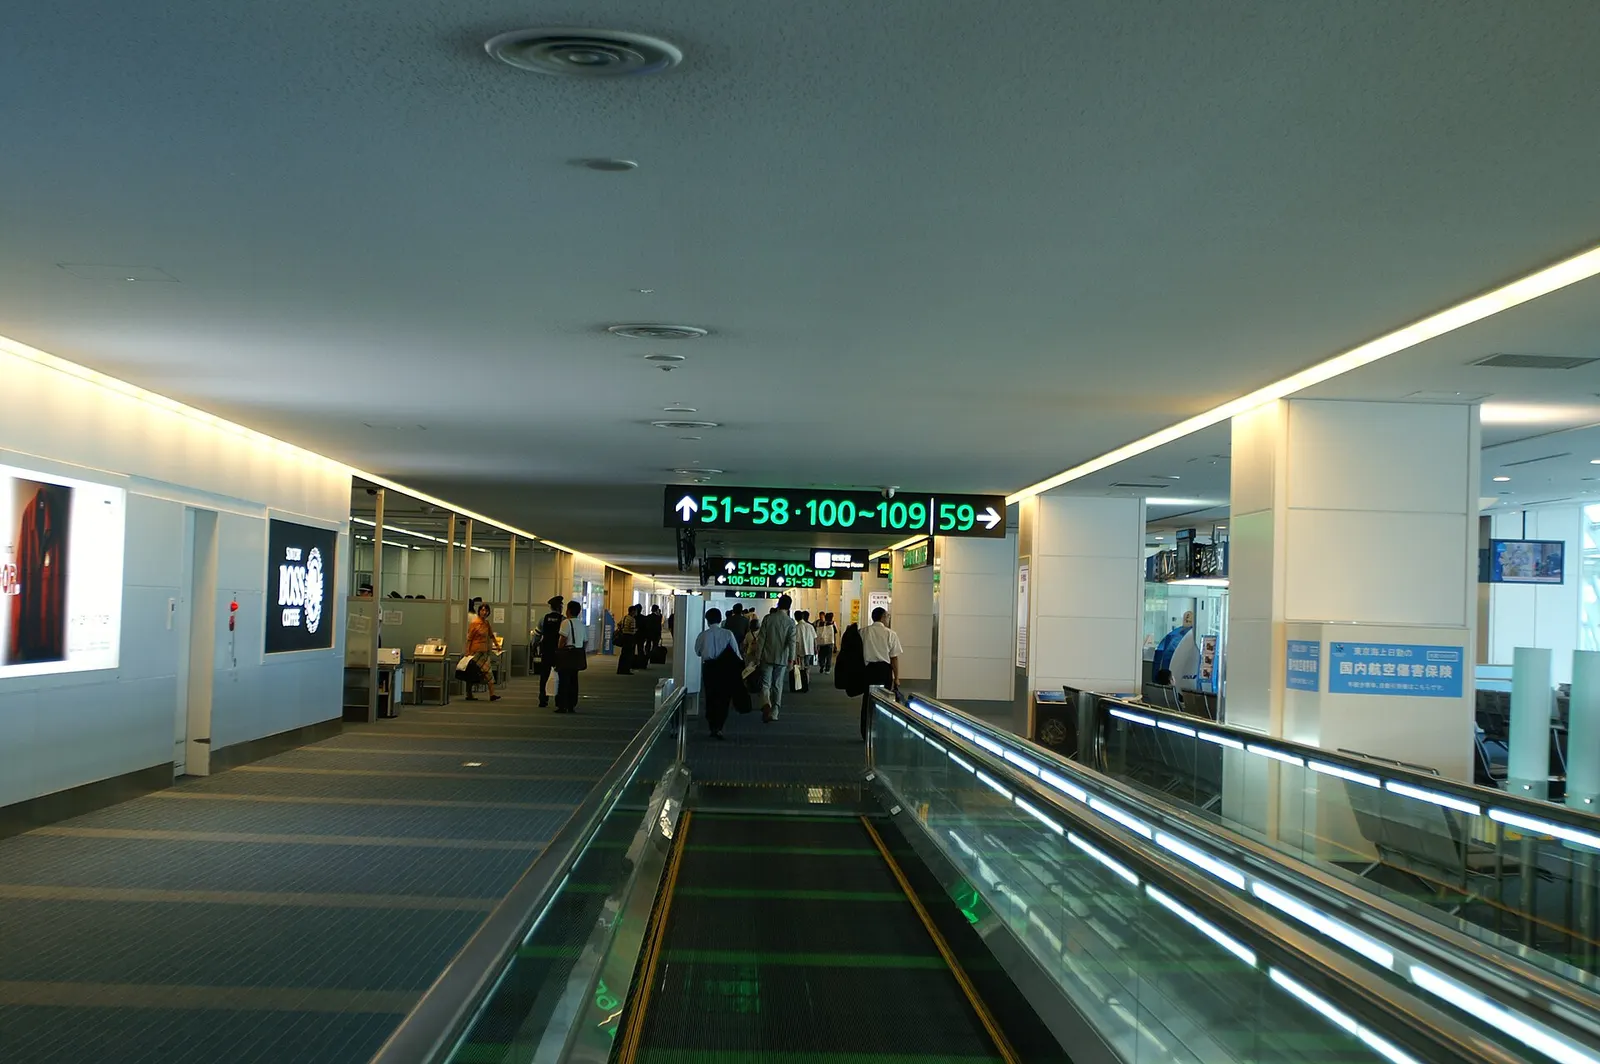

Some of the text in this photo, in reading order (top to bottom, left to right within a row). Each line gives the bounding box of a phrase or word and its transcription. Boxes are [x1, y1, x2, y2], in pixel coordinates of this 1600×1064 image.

[939, 504, 975, 531] 59
[279, 565, 306, 606] BOSS
[727, 575, 766, 586] 100~109
[785, 577, 814, 587] 51~58
